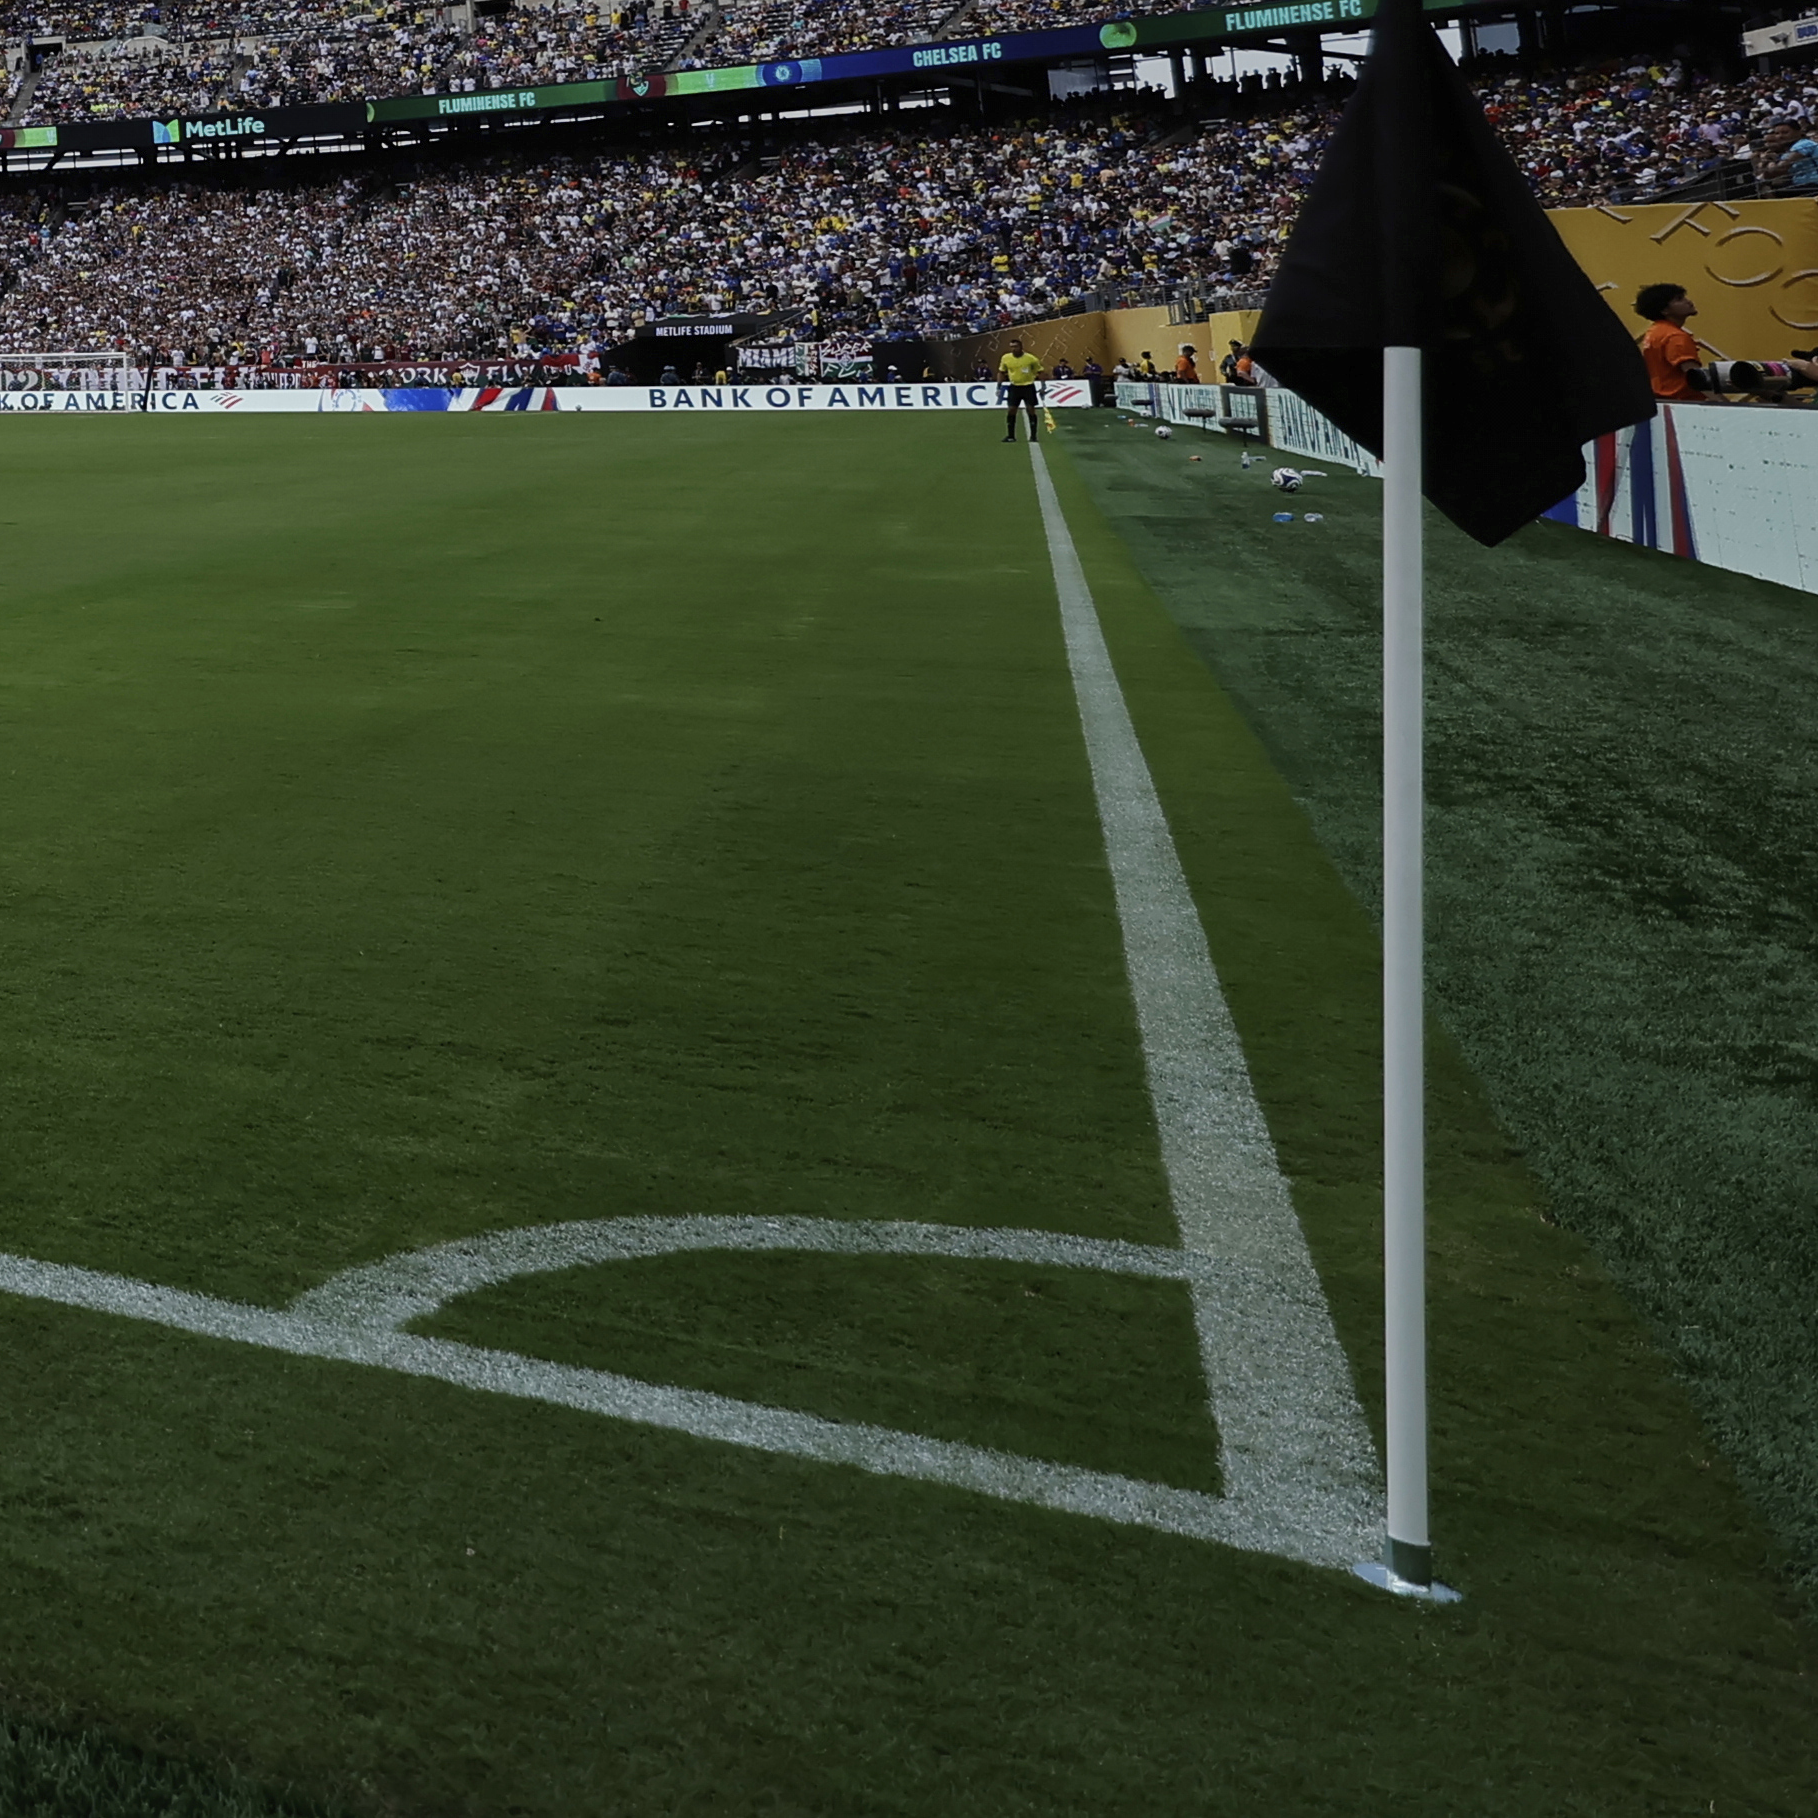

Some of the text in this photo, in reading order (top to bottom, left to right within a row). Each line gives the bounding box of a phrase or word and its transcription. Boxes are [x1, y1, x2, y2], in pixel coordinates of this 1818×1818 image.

[1225, 2, 1334, 32] FLUMINENSE
[912, 41, 1003, 68] CHELSEA FC
[438, 91, 536, 114] FLUMINENSE FC
[185, 116, 266, 139] MetLife
[655, 324, 733, 337] METLIFE STADIUM
[20, 393, 55, 411] OF
[64, 392, 200, 411] AMERICA
[649, 388, 753, 408] BANK
[765, 387, 813, 408] OF
